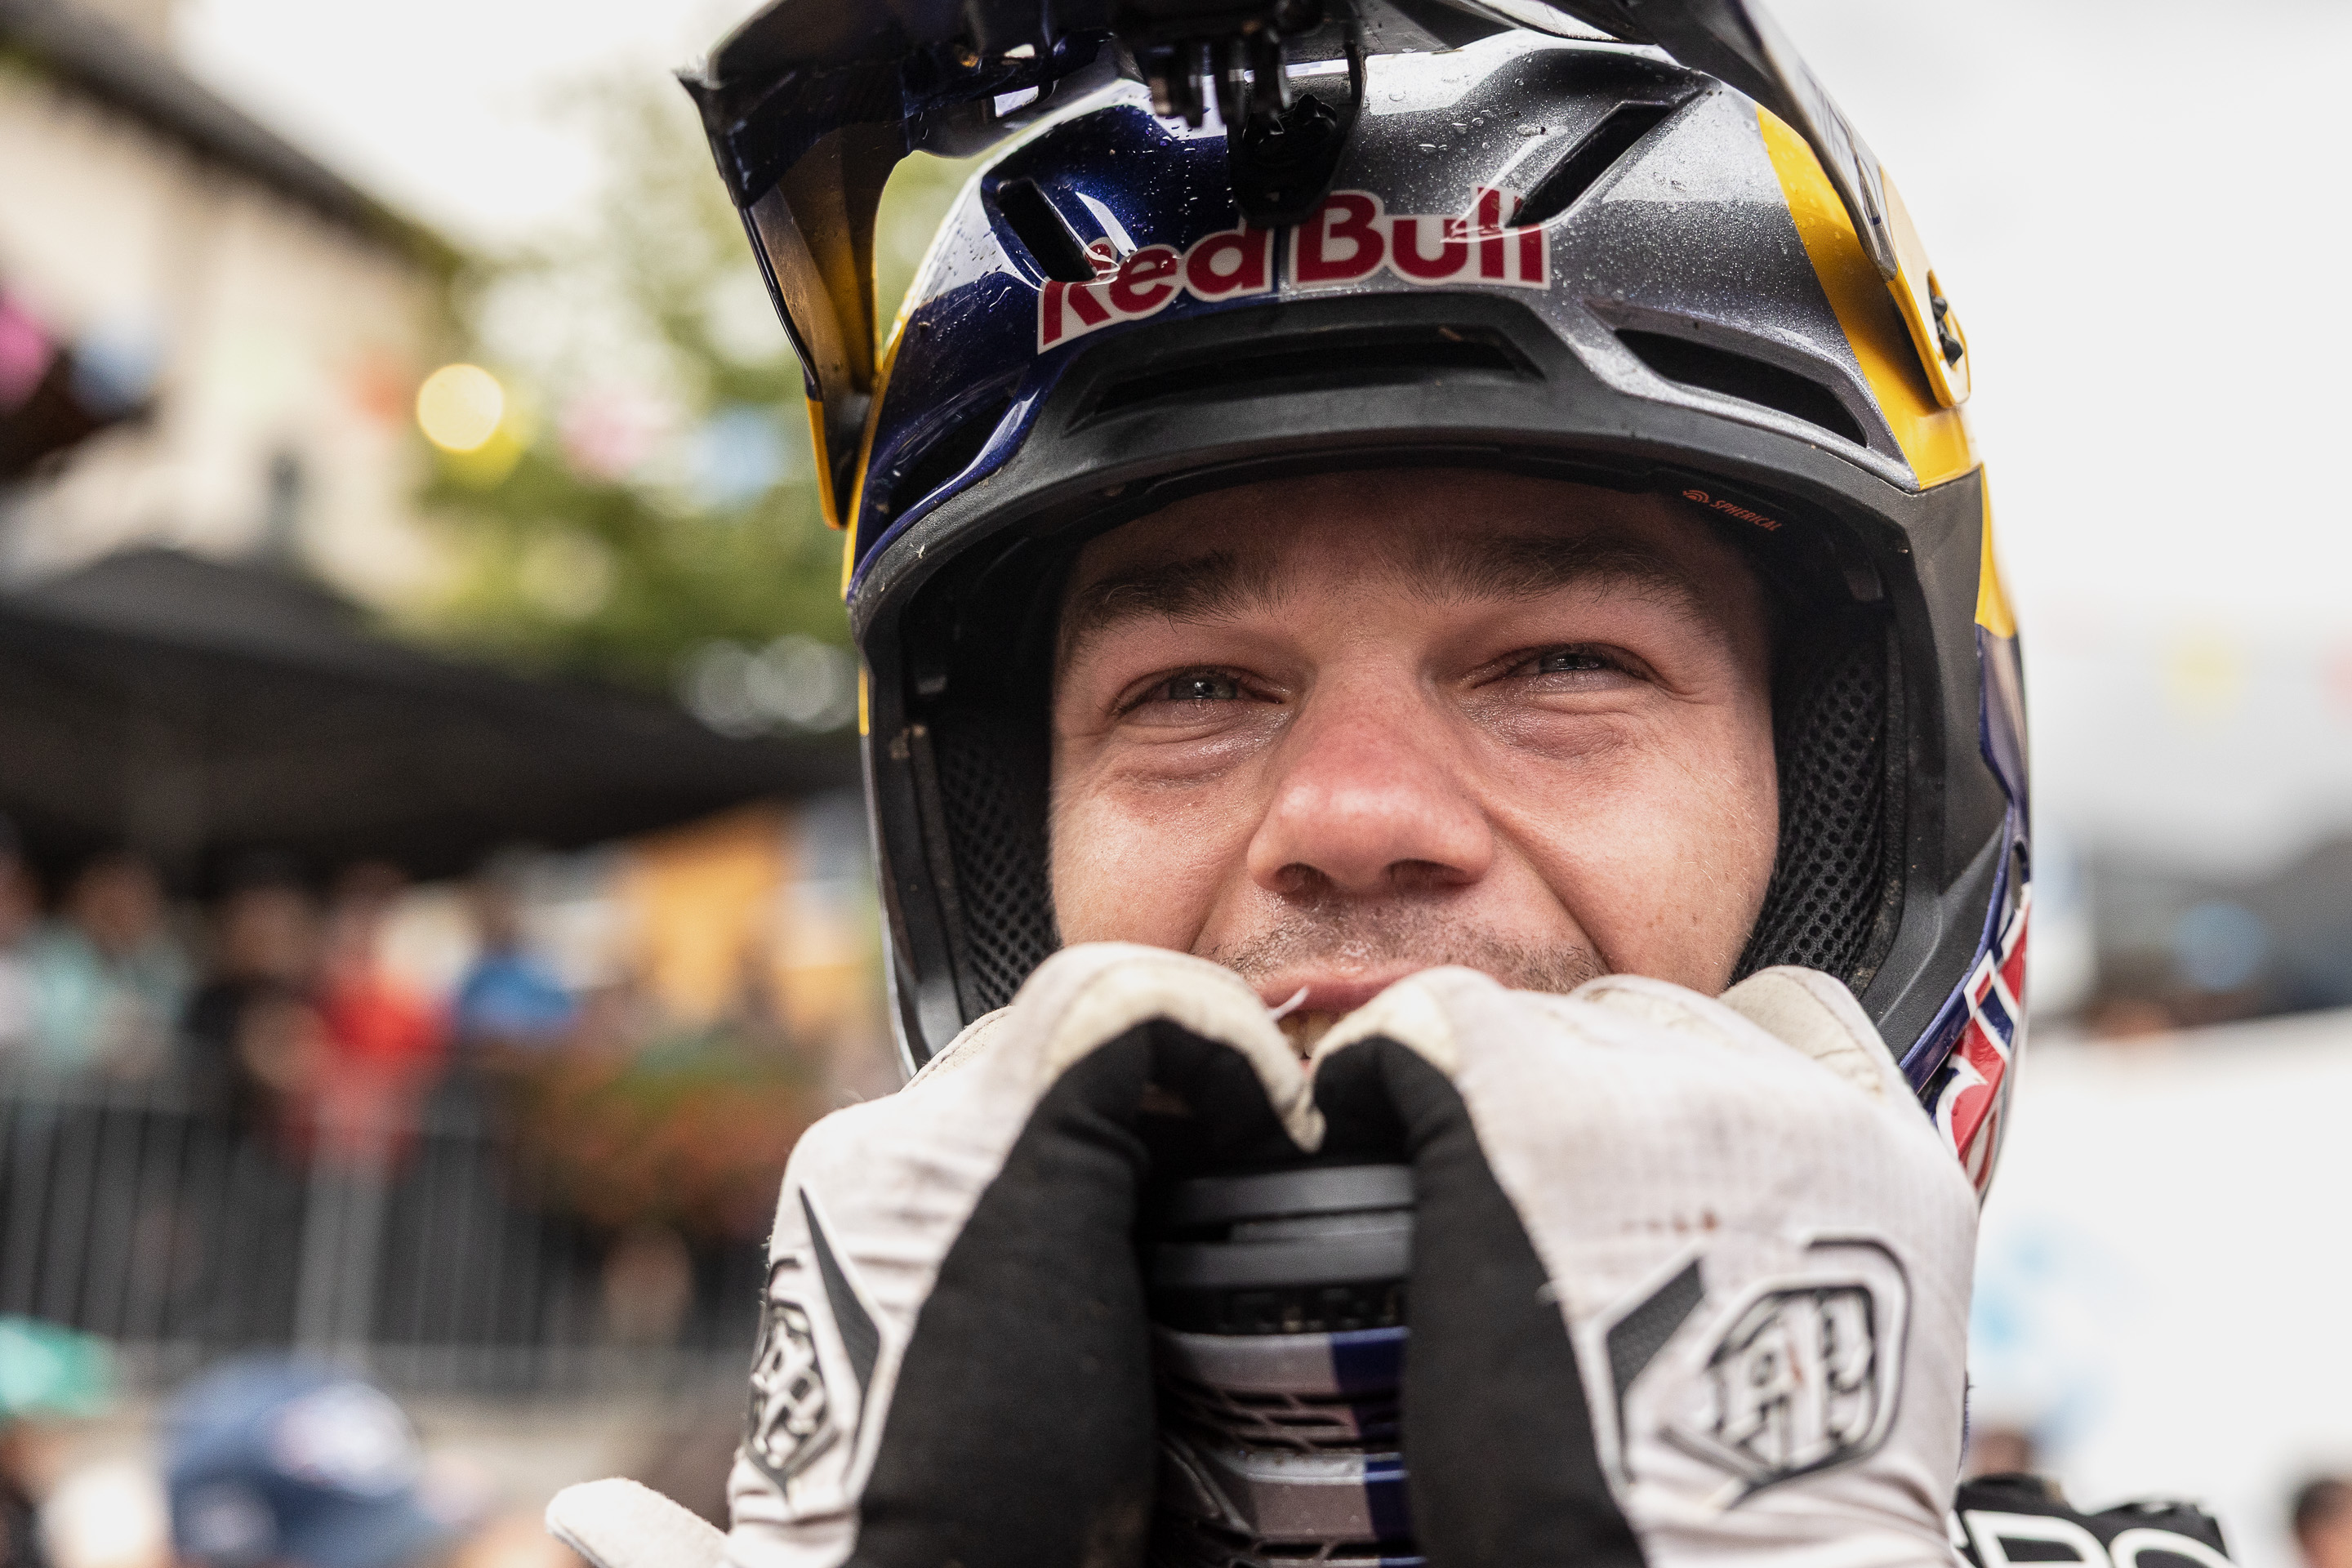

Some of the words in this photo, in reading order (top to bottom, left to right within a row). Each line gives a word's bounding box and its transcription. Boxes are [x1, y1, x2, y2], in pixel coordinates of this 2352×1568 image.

[1040, 220, 1272, 351] Red
[1292, 184, 1548, 287] Bull
[1710, 500, 1782, 531] SPHERICAL
